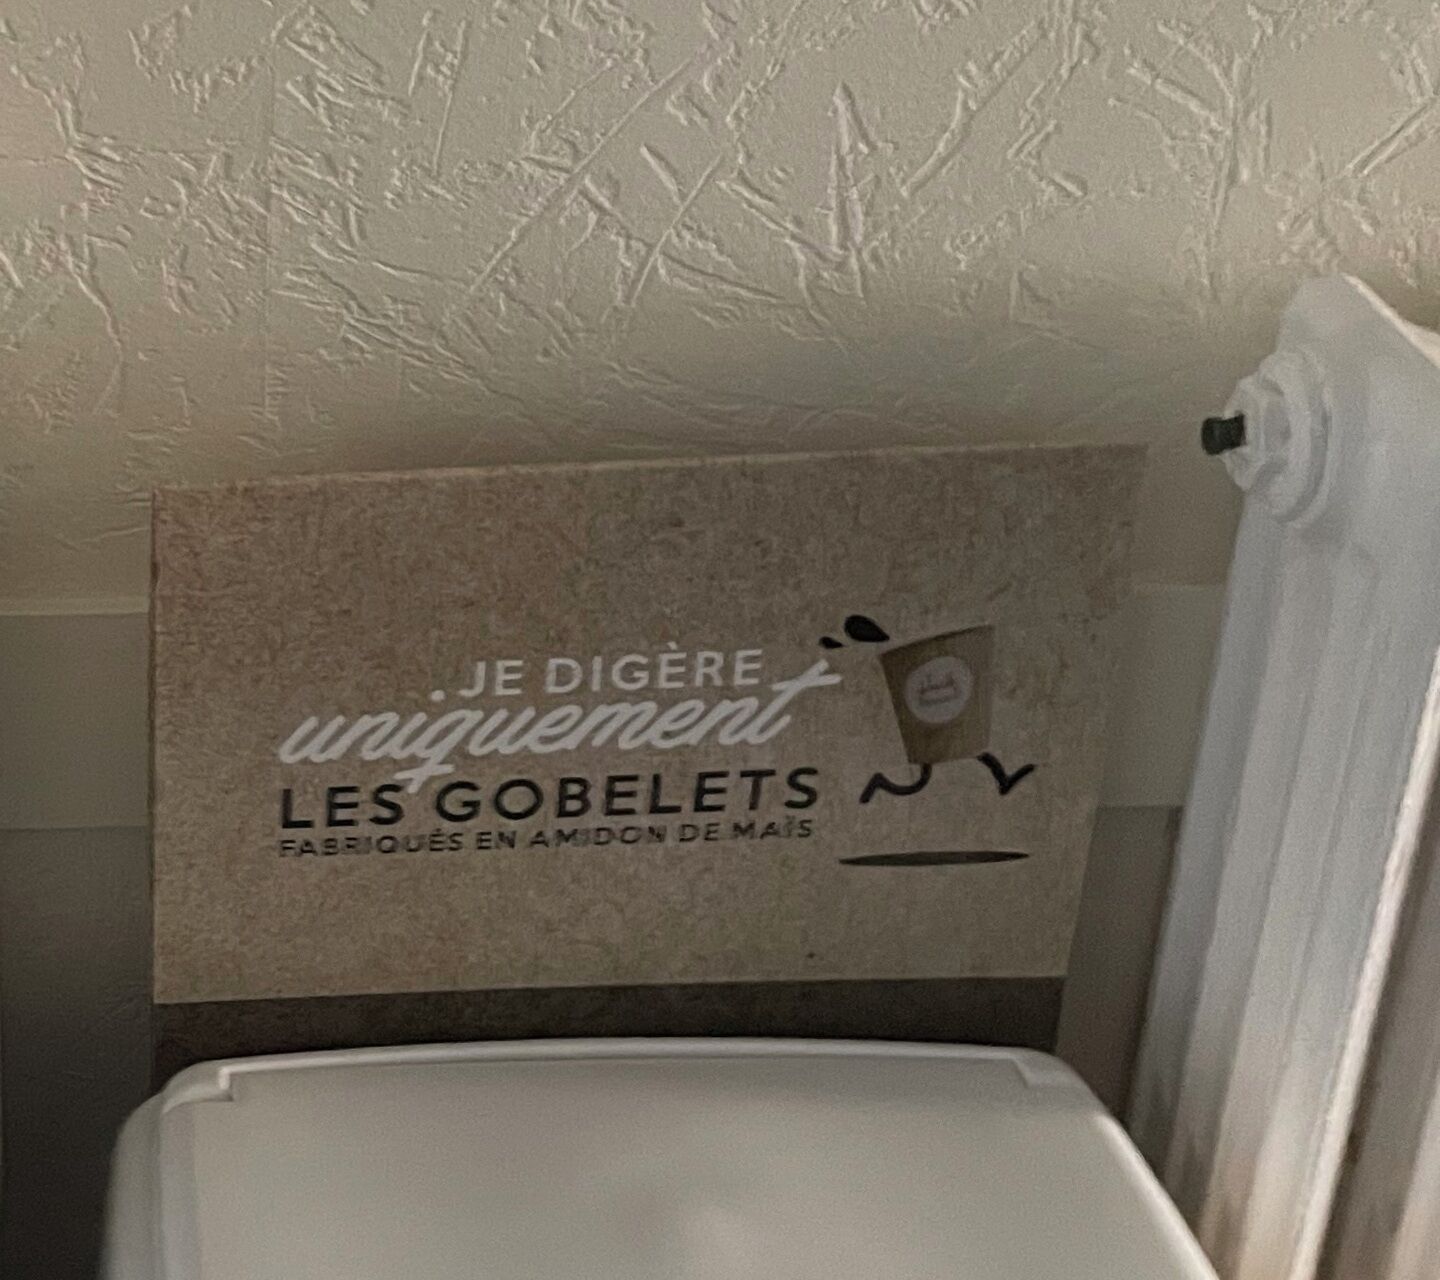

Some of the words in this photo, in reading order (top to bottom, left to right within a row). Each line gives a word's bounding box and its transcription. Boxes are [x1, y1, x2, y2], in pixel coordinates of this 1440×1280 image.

[458, 659, 526, 700] JE
[546, 643, 764, 695] DIGÈRE
[278, 659, 843, 793] uniquement
[281, 784, 406, 829] LES
[435, 767, 819, 821] GOBELETS
[279, 825, 463, 857] FABRIQUÉS
[477, 831, 516, 852] EN
[530, 824, 664, 849] AMIDON
[679, 822, 719, 843] DE
[732, 818, 812, 841] MAÏS
